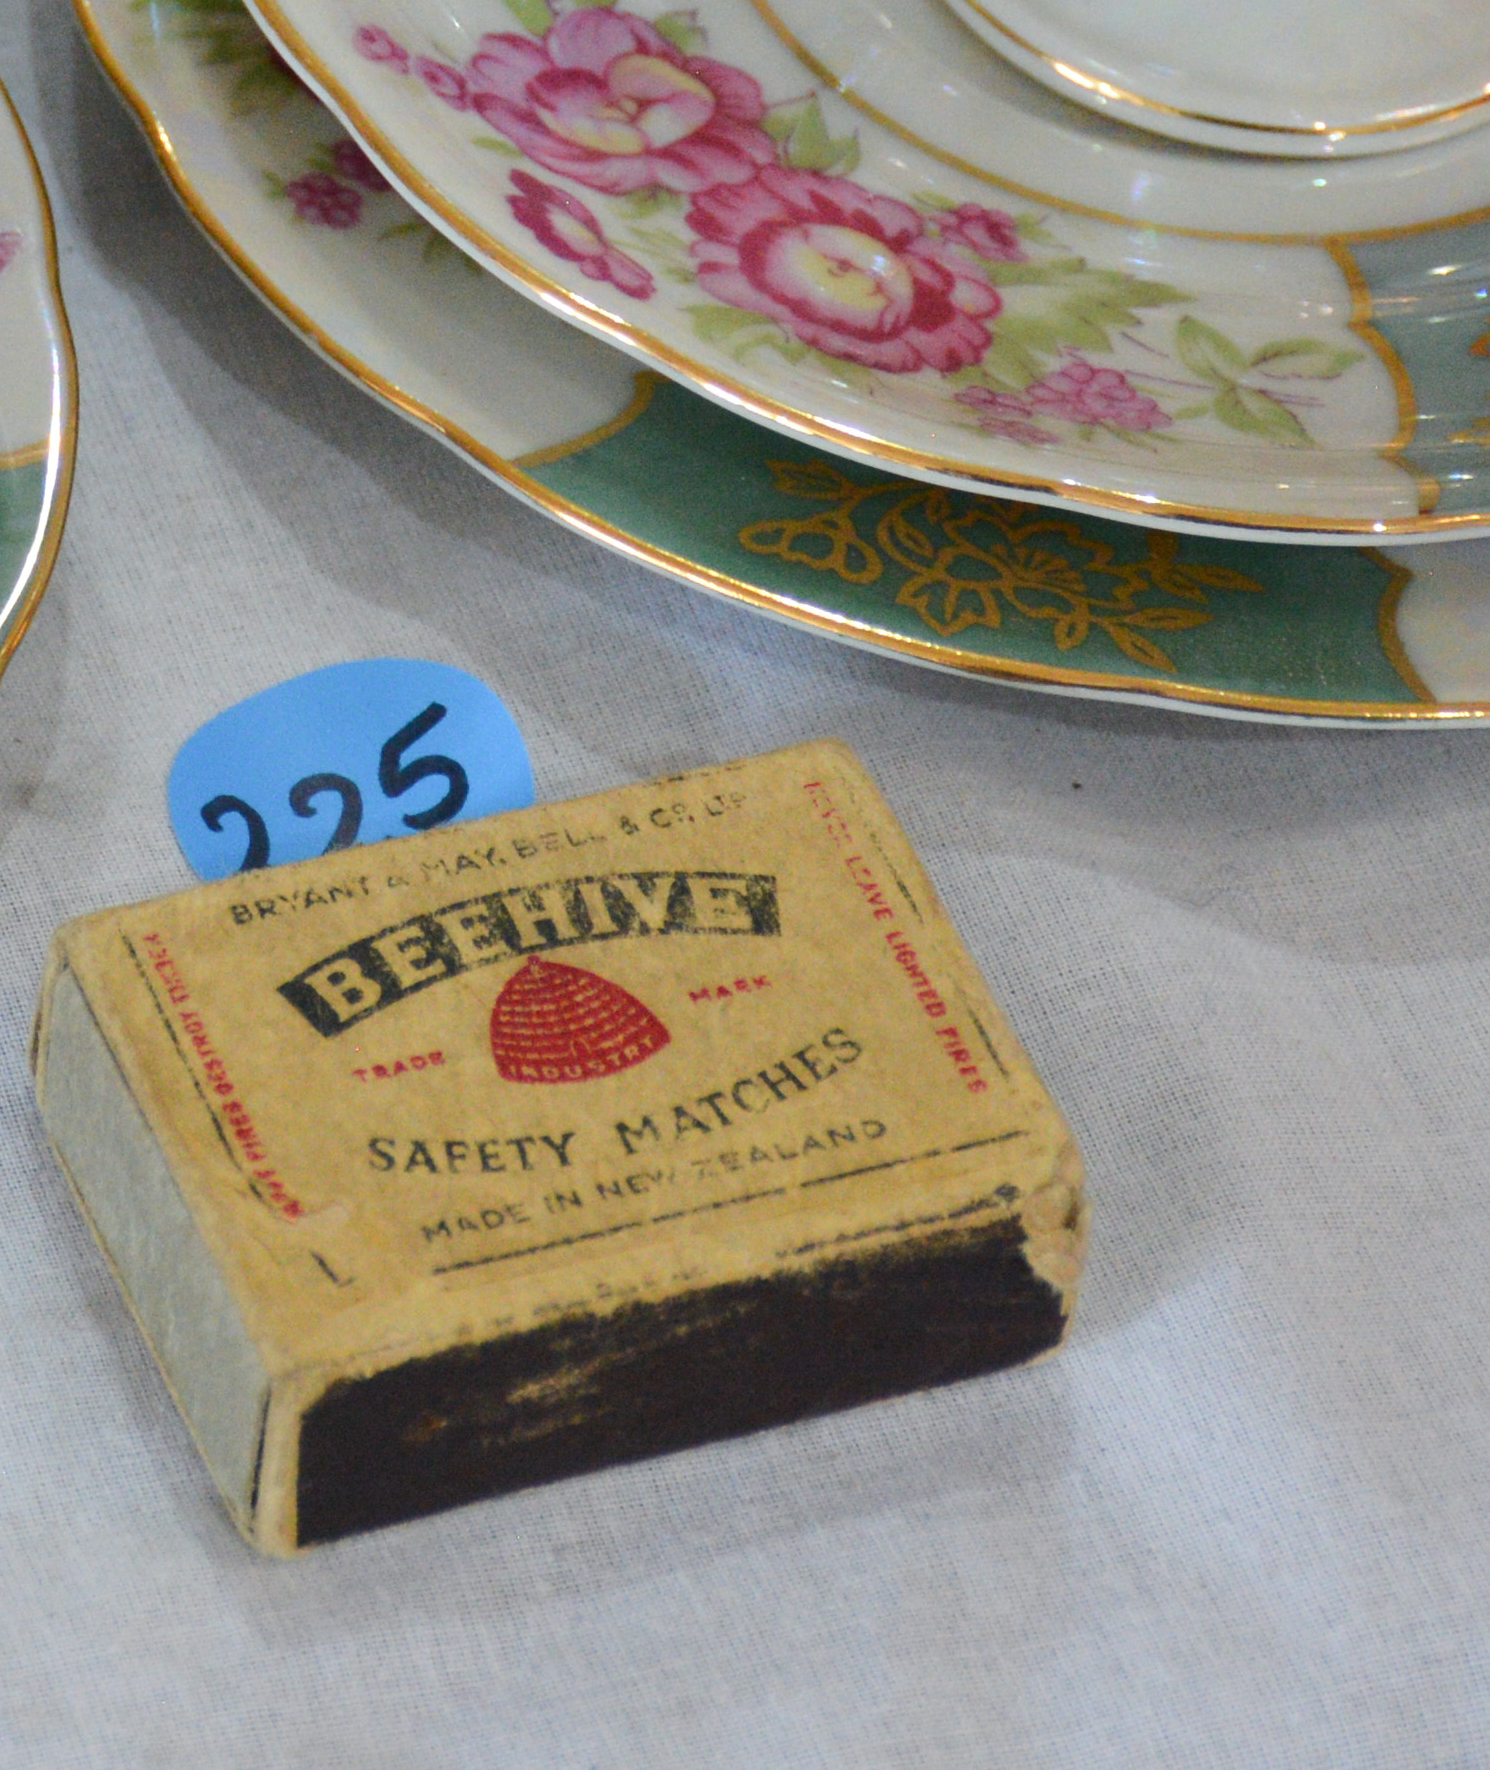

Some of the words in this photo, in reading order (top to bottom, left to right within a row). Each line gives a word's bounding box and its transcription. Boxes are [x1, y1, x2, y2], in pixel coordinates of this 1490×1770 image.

[200, 701, 470, 872] 225
[229, 875, 370, 926] BRYANT
[619, 815, 641, 836] &
[302, 875, 755, 1025] BEEHIVE
[885, 930, 947, 1018] LIGHTED
[179, 1011, 234, 1096] DESTROY
[352, 1050, 447, 1084] TRADE
[688, 974, 775, 1005] MARK
[508, 1033, 655, 1080] INDUSTRY
[367, 1131, 577, 1175] SAFETY
[614, 1026, 864, 1158] MATCHES
[422, 1203, 532, 1243] MADE
[543, 1188, 584, 1217] IN
[596, 1167, 678, 1202] NEW
